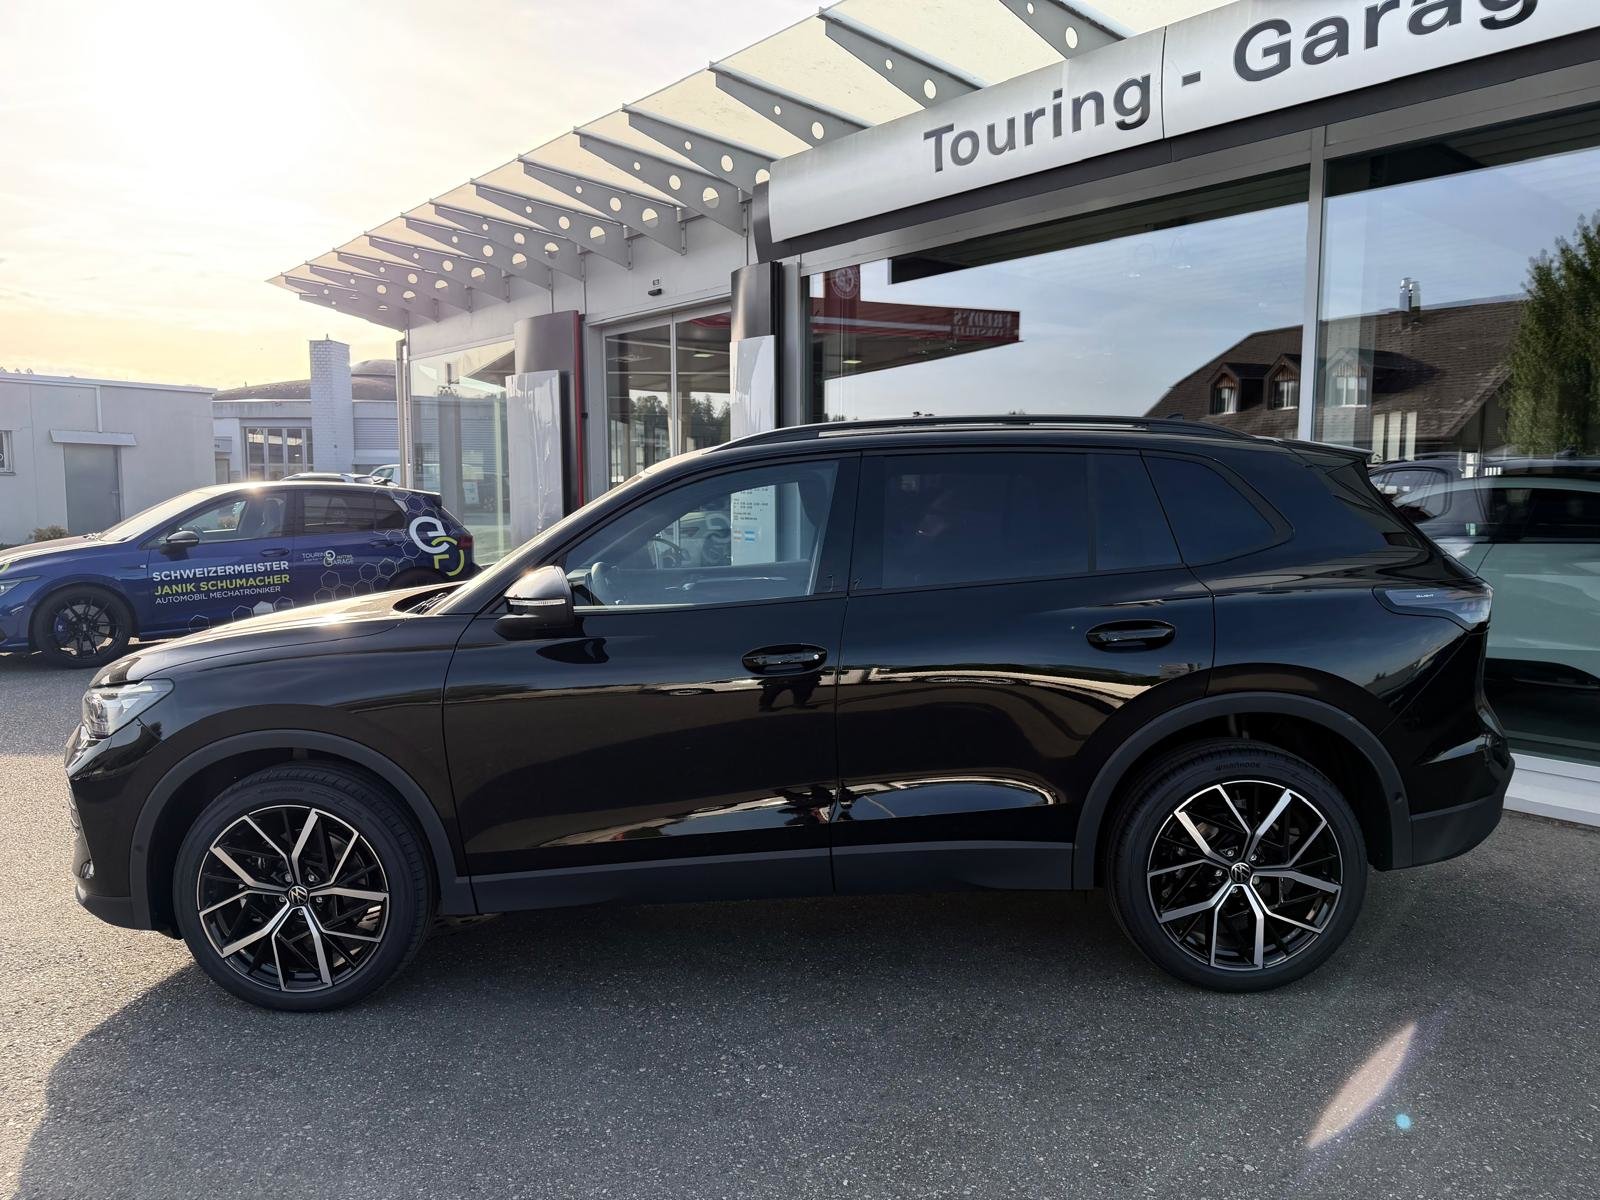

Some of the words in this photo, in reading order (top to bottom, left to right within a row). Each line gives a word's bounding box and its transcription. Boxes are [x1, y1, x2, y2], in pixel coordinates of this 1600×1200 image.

[923, 72, 1152, 173] Touring
[1180, 70, 1202, 87] -
[152, 560, 289, 582] SCHWEIZERMEISTER
[154, 582, 196, 596] JANIK
[200, 574, 290, 591] SCHUMACHER
[155, 593, 208, 605] AUTOMOBIL
[209, 585, 281, 599] MECHATRONIKER
